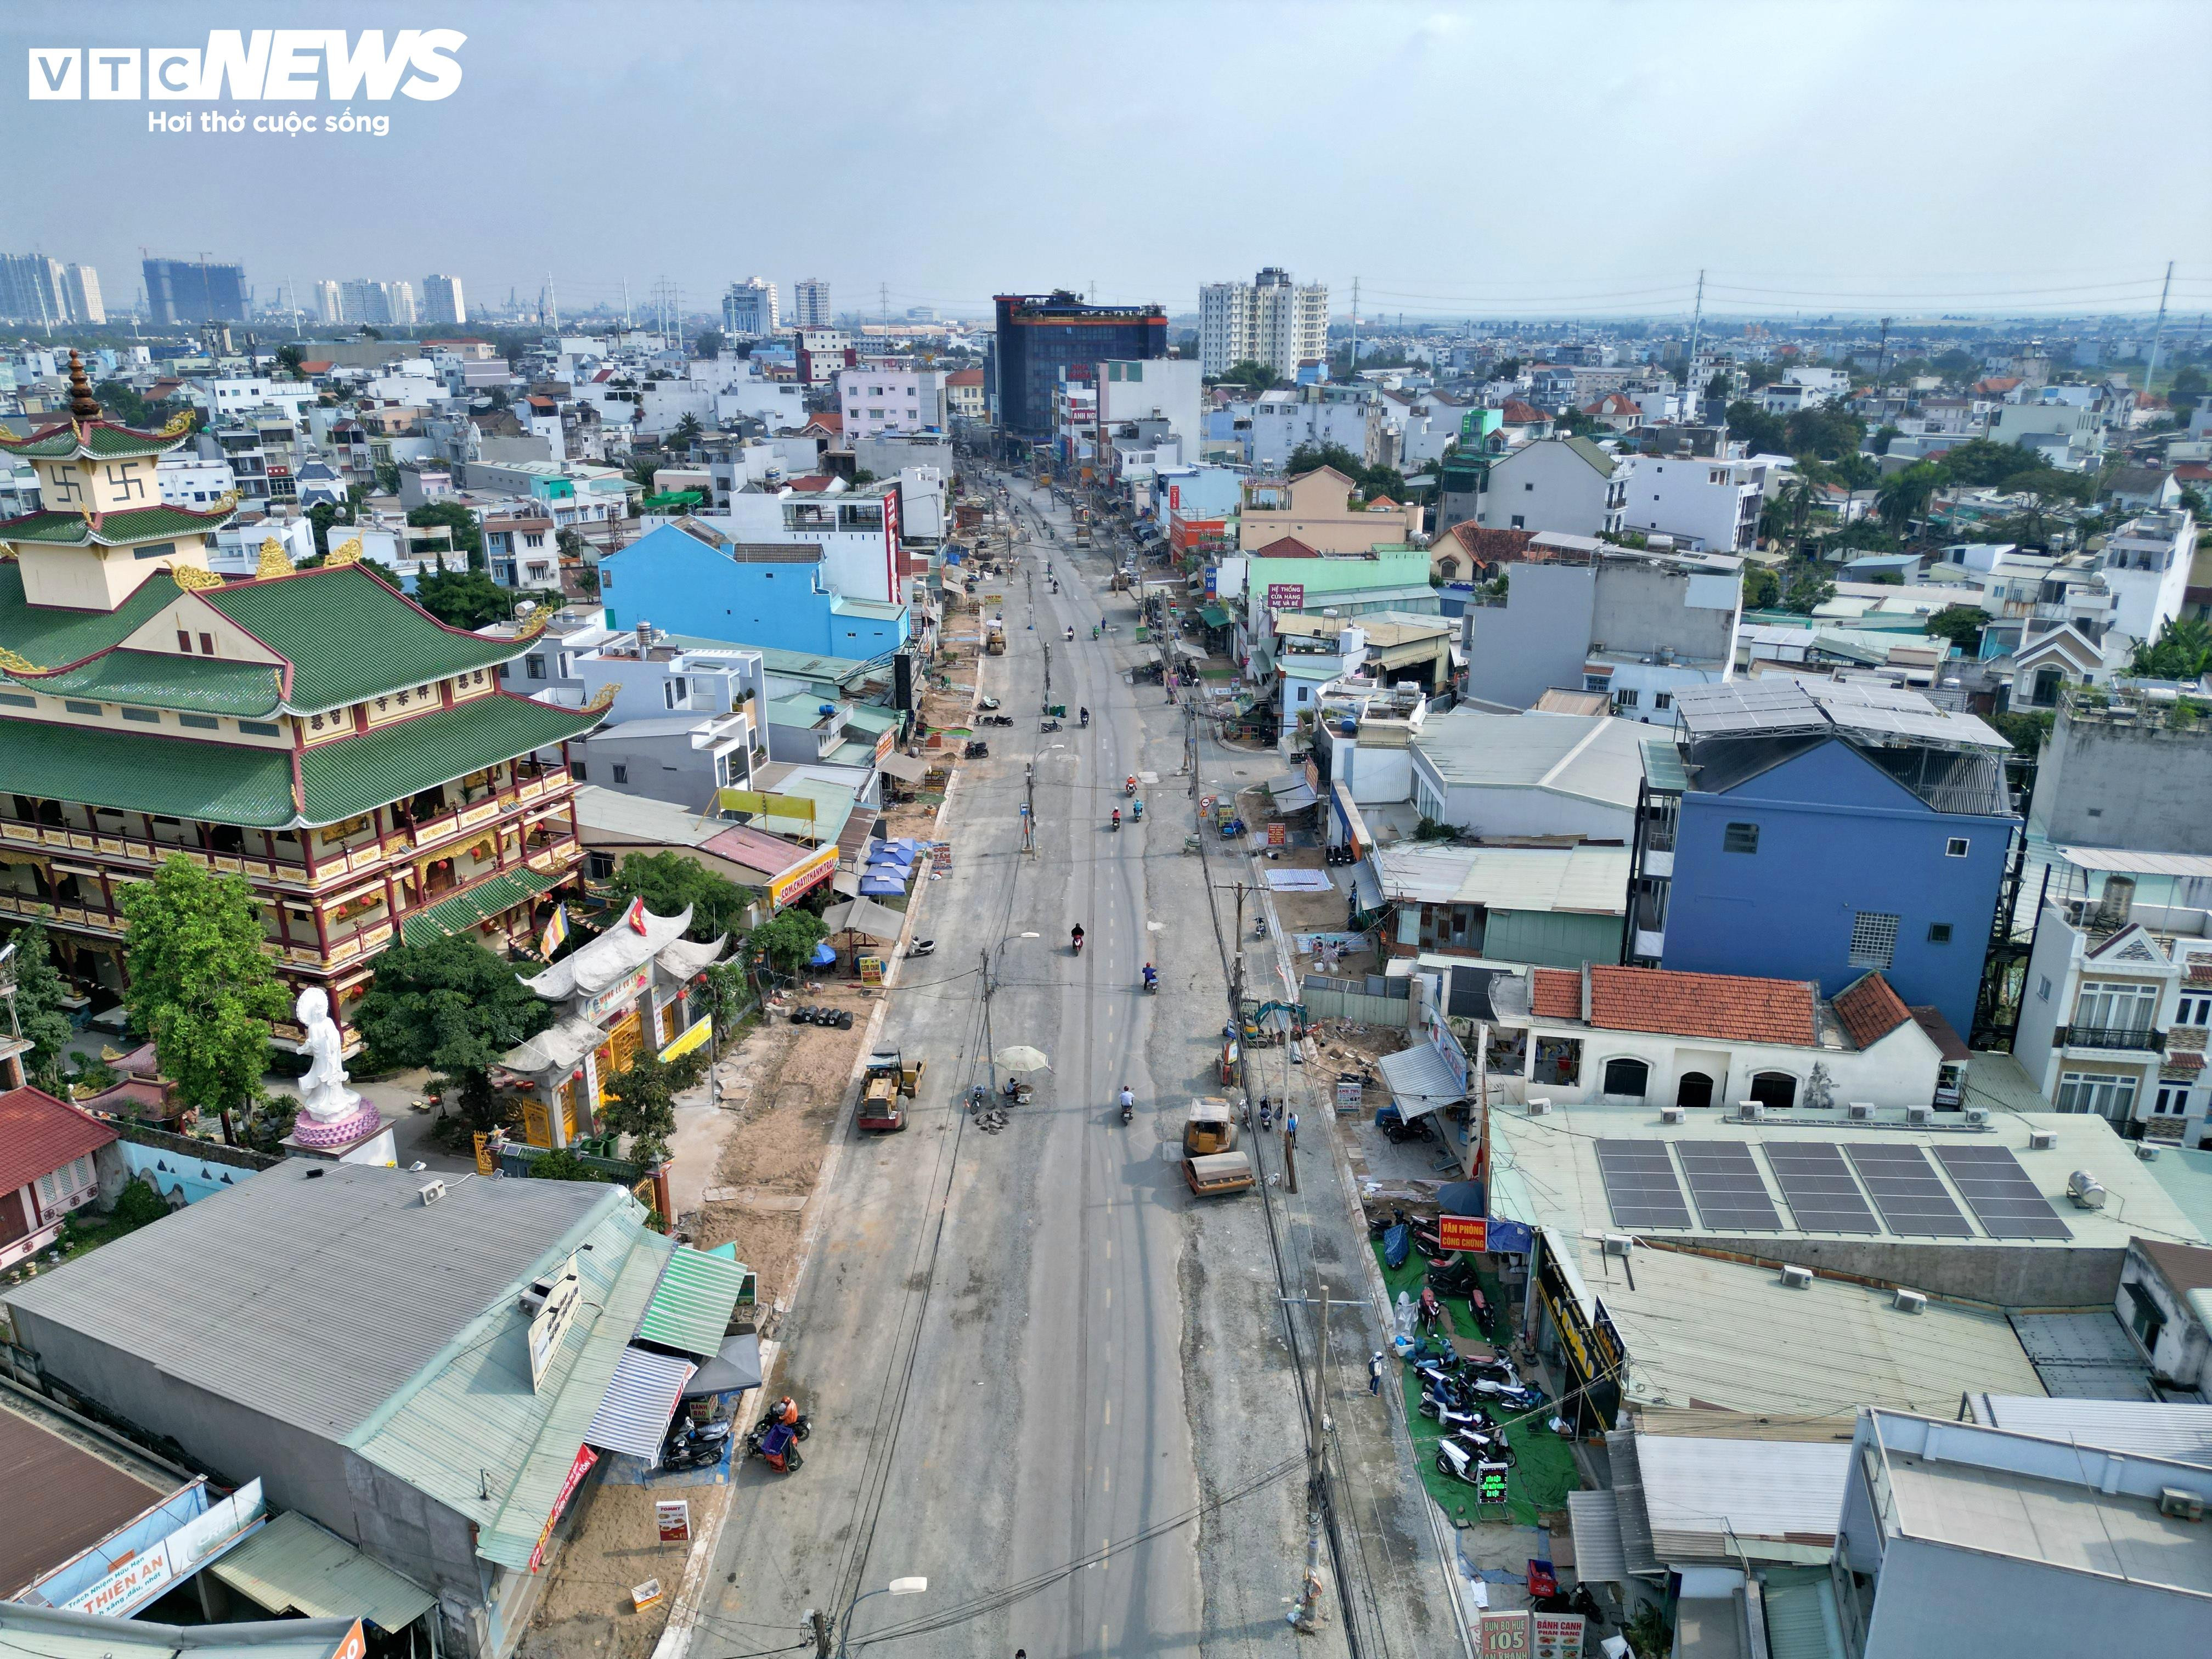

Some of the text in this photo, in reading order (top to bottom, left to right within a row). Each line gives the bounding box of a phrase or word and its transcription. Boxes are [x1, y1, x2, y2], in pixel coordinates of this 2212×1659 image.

[807, 866, 823, 882] THANH
[1443, 1222, 1483, 1235] VĂN PHÒNG
[1442, 1236, 1483, 1248] CÔNG CHỨNG
[69, 1556, 144, 1609] Trách Nhiệm Hữu Hạn
[83, 1573, 137, 1615] THIÊN
[142, 1555, 163, 1579] AN
[106, 1597, 125, 1611] xăng
[1537, 1620, 1582, 1630] BÁNH CANH
[1489, 1631, 1524, 1650] 105
